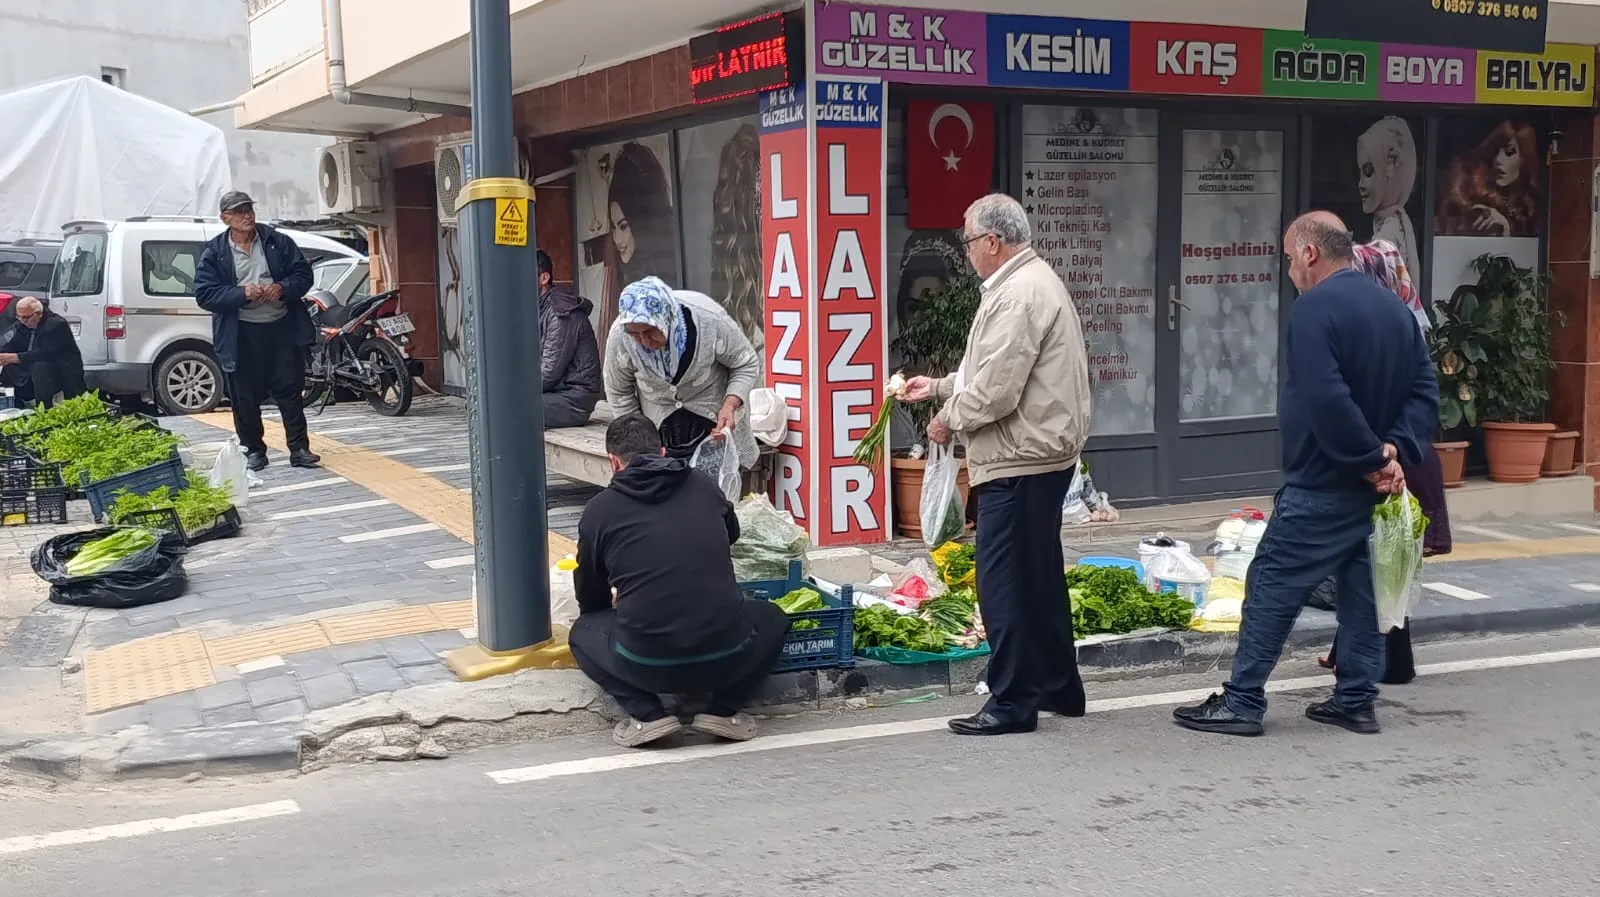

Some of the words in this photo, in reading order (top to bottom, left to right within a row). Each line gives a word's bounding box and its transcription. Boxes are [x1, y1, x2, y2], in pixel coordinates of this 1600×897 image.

[1444, 0, 1474, 14] 0507
[1477, 1, 1501, 17] 376
[1504, 4, 1520, 18] 54
[1522, 5, 1538, 20] 04
[850, 11, 877, 36] M
[888, 14, 915, 40] &
[923, 16, 946, 41] K
[822, 38, 976, 75] GÜZELLİK
[1005, 28, 1111, 75] KESİM
[1156, 40, 1238, 85] KAŞ
[1272, 44, 1367, 84] AĞDA
[1386, 55, 1464, 86] BOYA
[1485, 58, 1588, 93] BALYAJ
[827, 84, 838, 99] M
[842, 83, 854, 99] &
[857, 84, 868, 100] K
[762, 103, 804, 127] GÜZELLİK
[815, 102, 879, 122] GÜZELLİK
[1046, 151, 1087, 160] GÜZELLİK
[1037, 169, 1066, 181] Lazer
[1067, 169, 1117, 184] epilasyon
[1037, 186, 1064, 198] Gelin
[1037, 204, 1104, 217] Microplading
[1037, 220, 1051, 233] Kıl
[1054, 220, 1090, 235] Tekniği
[1037, 240, 1067, 251] Kiprik
[1070, 239, 1102, 252] Lifting
[1182, 242, 1275, 260] Hoşgeldiniz
[1072, 255, 1103, 269] Balyaj
[1068, 271, 1103, 285] Makyaj
[1185, 275, 1214, 285] 0507
[1217, 274, 1238, 283] 376
[1241, 273, 1255, 283] 54
[1258, 272, 1272, 282] 04
[1100, 287, 1116, 298] Cilt
[1096, 305, 1113, 316] Cilt
[1086, 321, 1123, 334] Peeling
[767, 152, 806, 521] LAZER
[820, 142, 880, 534] LAZER
